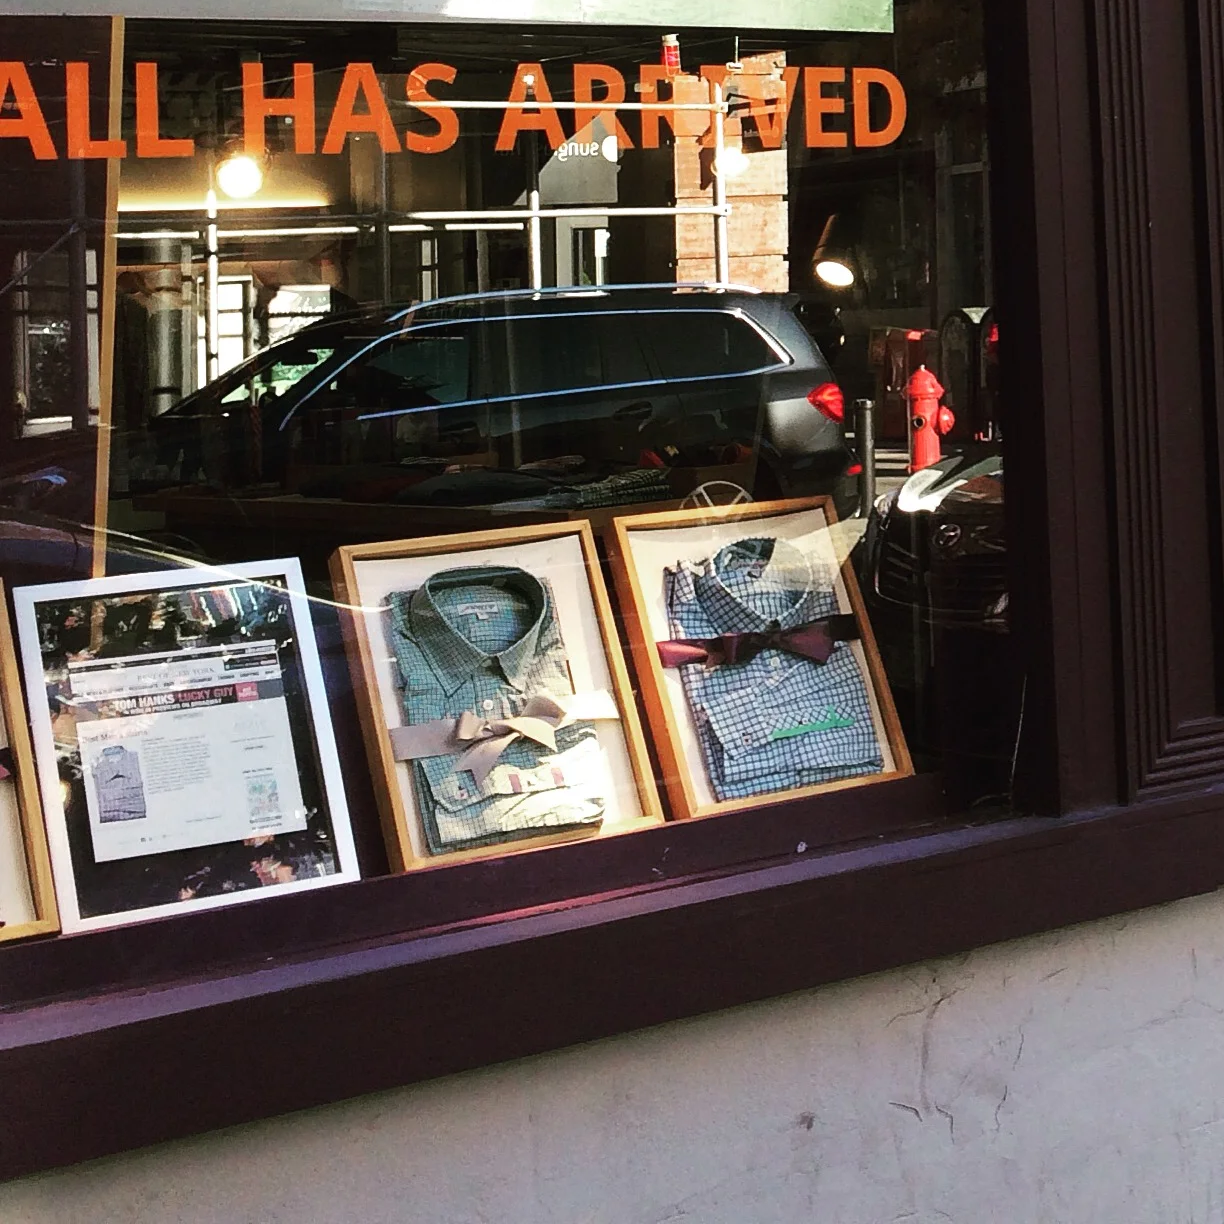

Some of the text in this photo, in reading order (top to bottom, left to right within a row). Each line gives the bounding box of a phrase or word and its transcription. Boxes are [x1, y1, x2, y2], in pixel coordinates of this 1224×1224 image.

[0, 61, 907, 160] ALL HAS ARRIVED
[113, 699, 138, 711] TOM
[138, 693, 175, 710] HANKS
[177, 688, 211, 703] LUCKY
[213, 683, 234, 698] GUY
